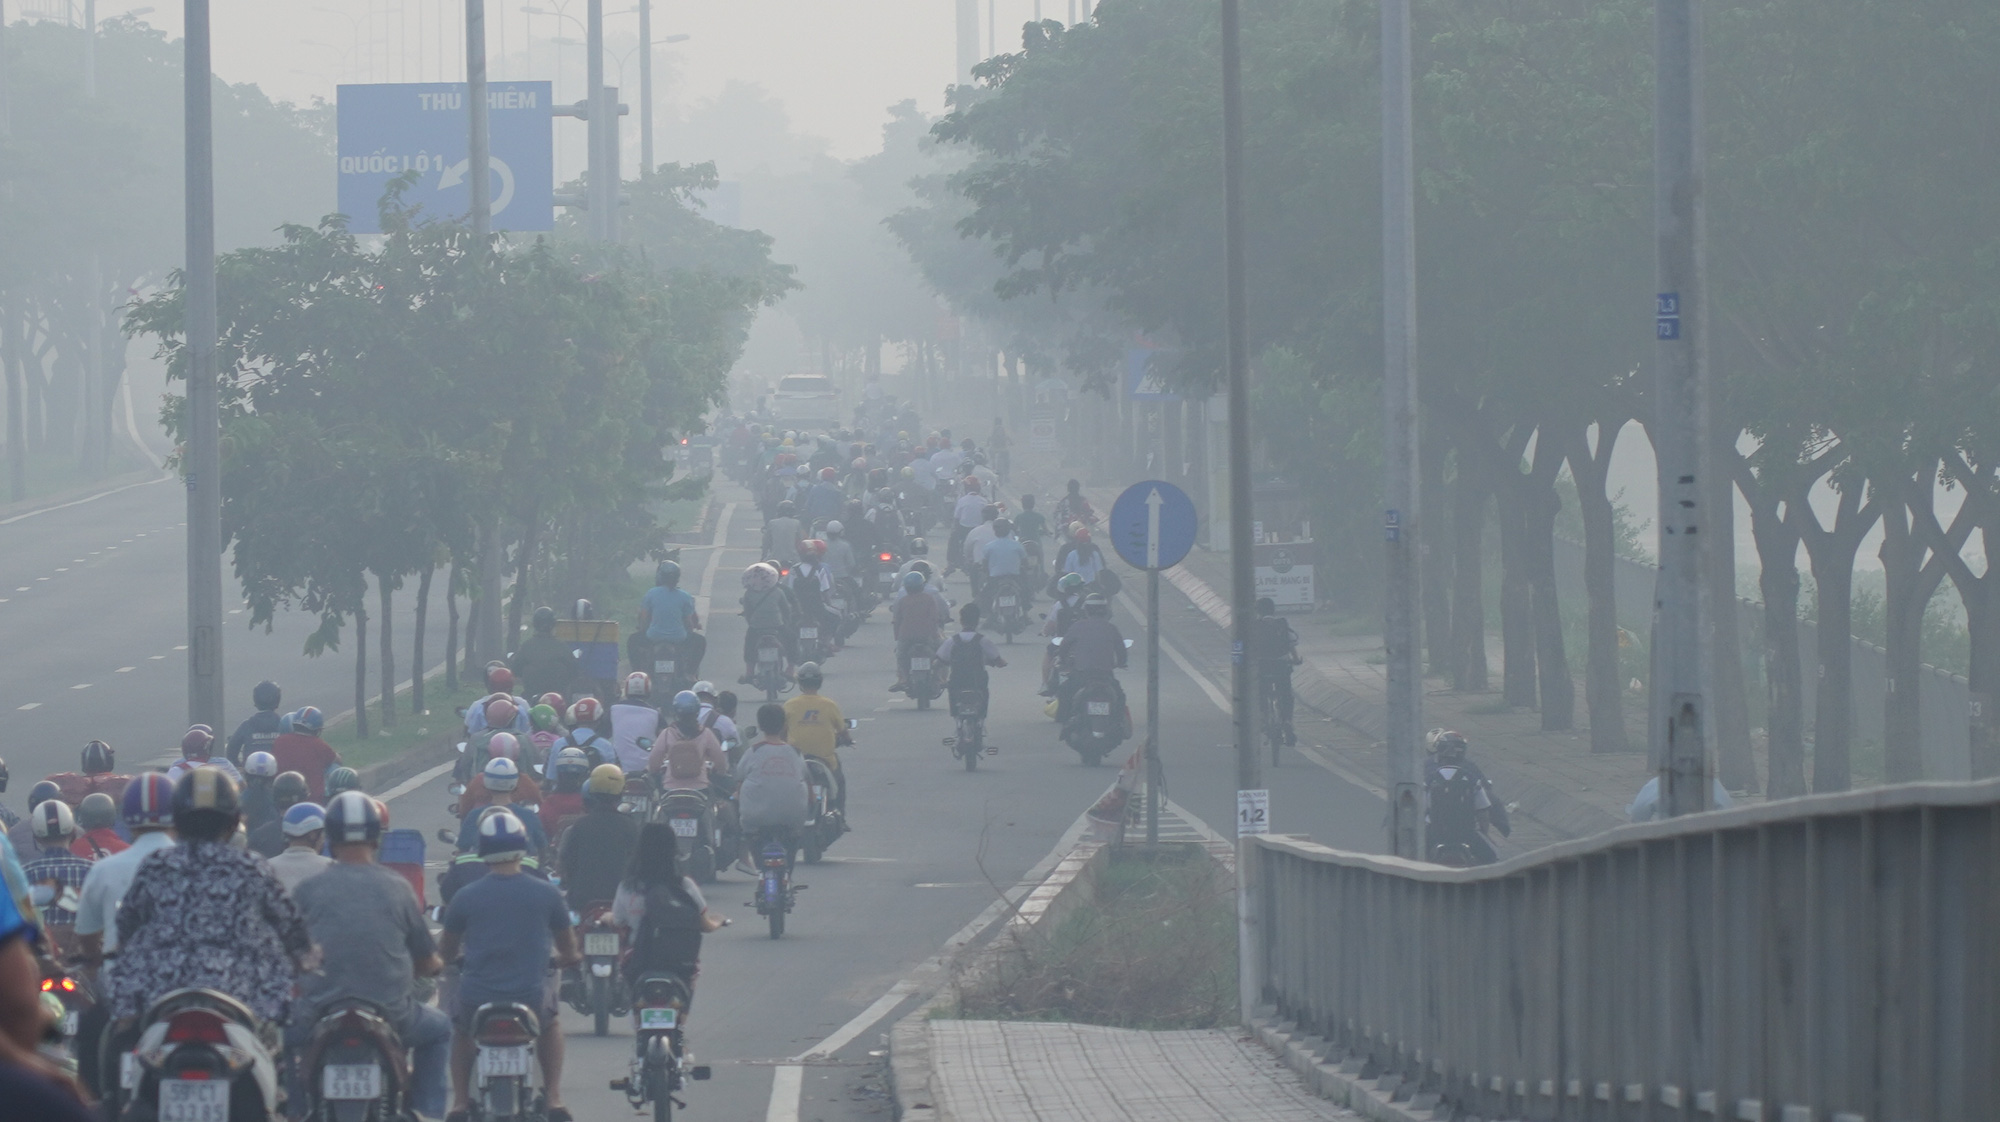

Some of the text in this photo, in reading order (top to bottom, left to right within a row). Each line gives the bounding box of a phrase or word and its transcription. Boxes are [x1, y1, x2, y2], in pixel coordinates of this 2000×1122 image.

[418, 84, 536, 110] THỦ HIÊM
[340, 147, 398, 175] QUỐC
[433, 154, 443, 172] 1
[1658, 323, 1671, 335] 73
